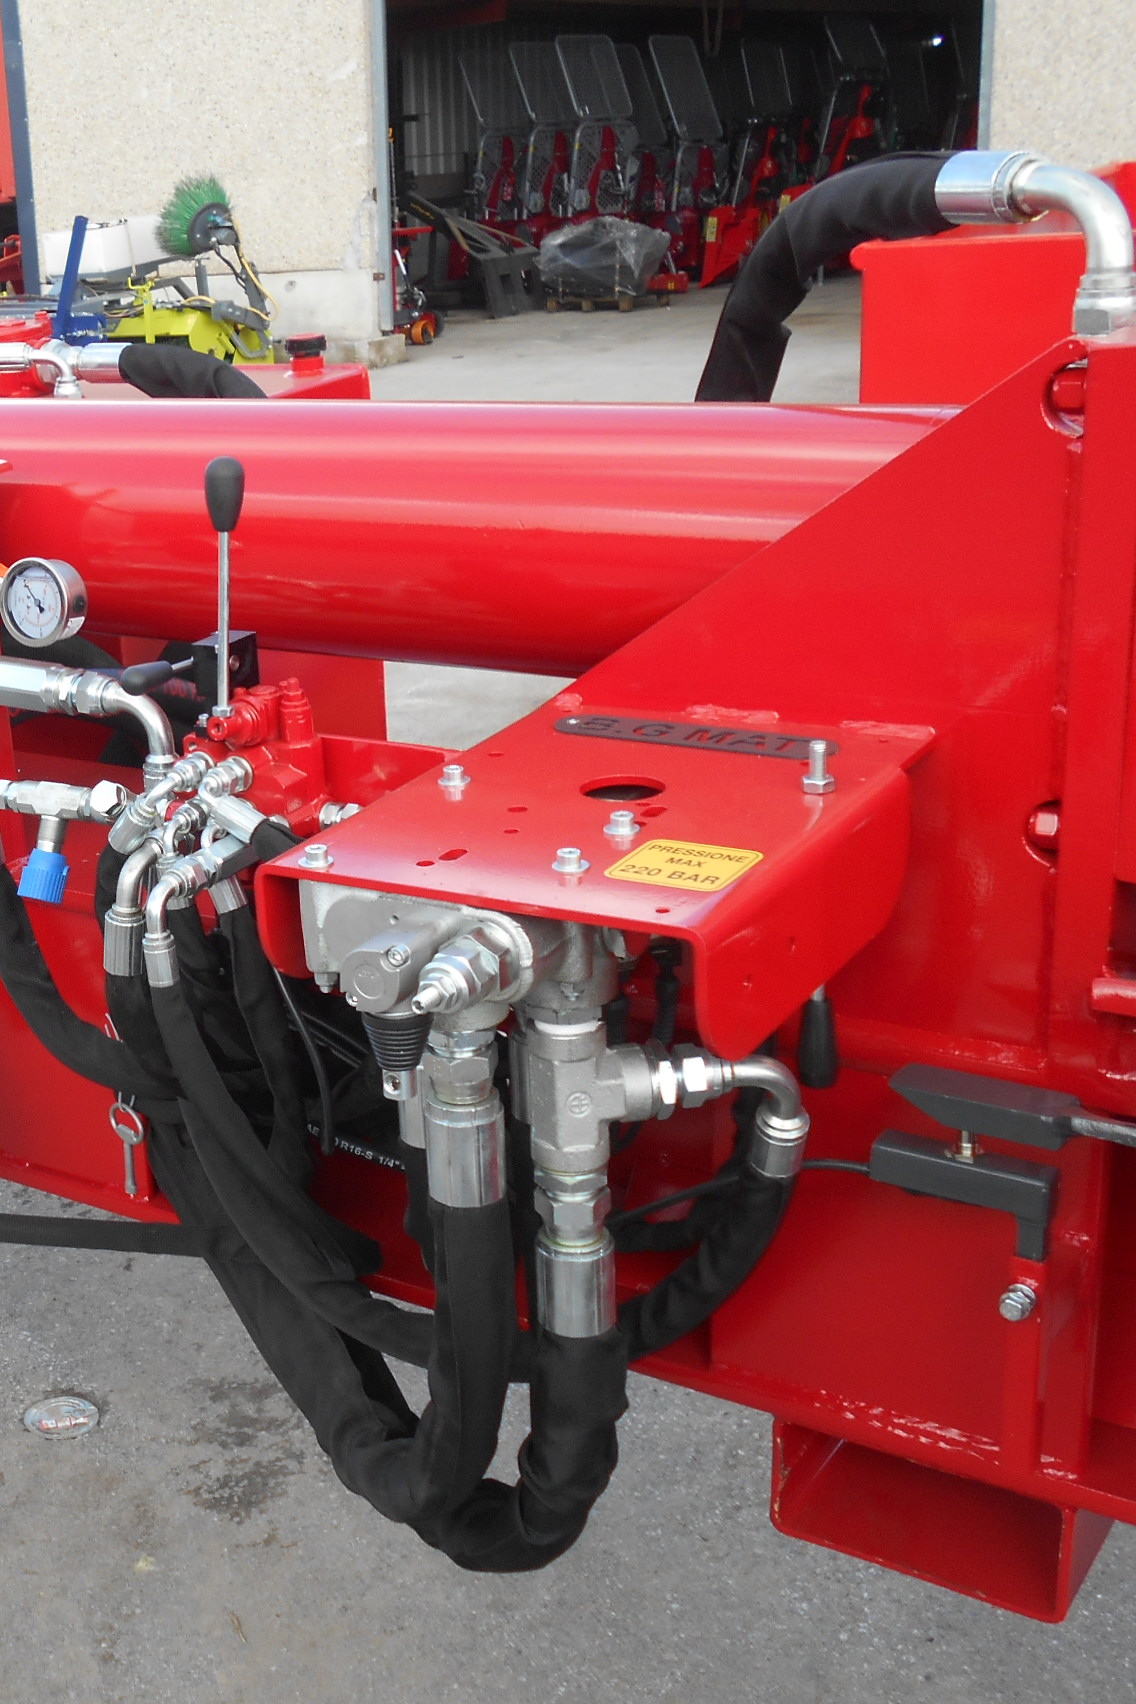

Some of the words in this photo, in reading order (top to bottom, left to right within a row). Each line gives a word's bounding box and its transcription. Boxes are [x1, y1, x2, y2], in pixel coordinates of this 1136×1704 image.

[685, 727, 812, 752] MAT
[648, 844, 750, 863] PRESSIONE
[665, 857, 707, 868] MAX
[619, 864, 662, 877] 220
[667, 870, 720, 885] BAR
[340, 1137, 374, 1161] R16-S
